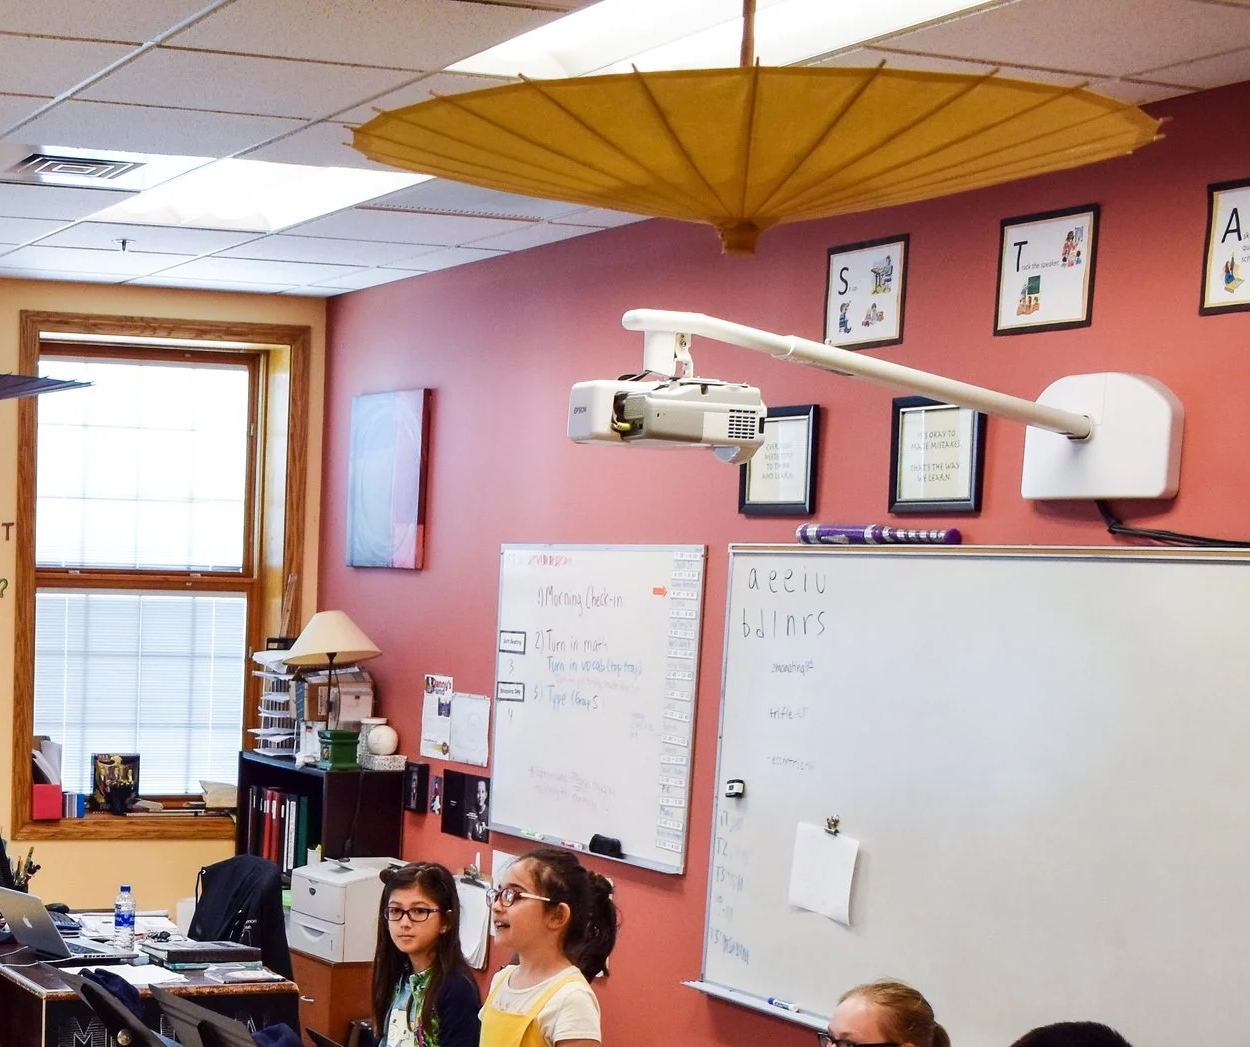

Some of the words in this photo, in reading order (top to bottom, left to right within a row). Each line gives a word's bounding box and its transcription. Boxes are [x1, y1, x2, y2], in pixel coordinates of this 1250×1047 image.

[573, 406, 587, 415] EPSON
[911, 442, 928, 450] MAE
[570, 635, 579, 652] in
[569, 657, 578, 672] in
